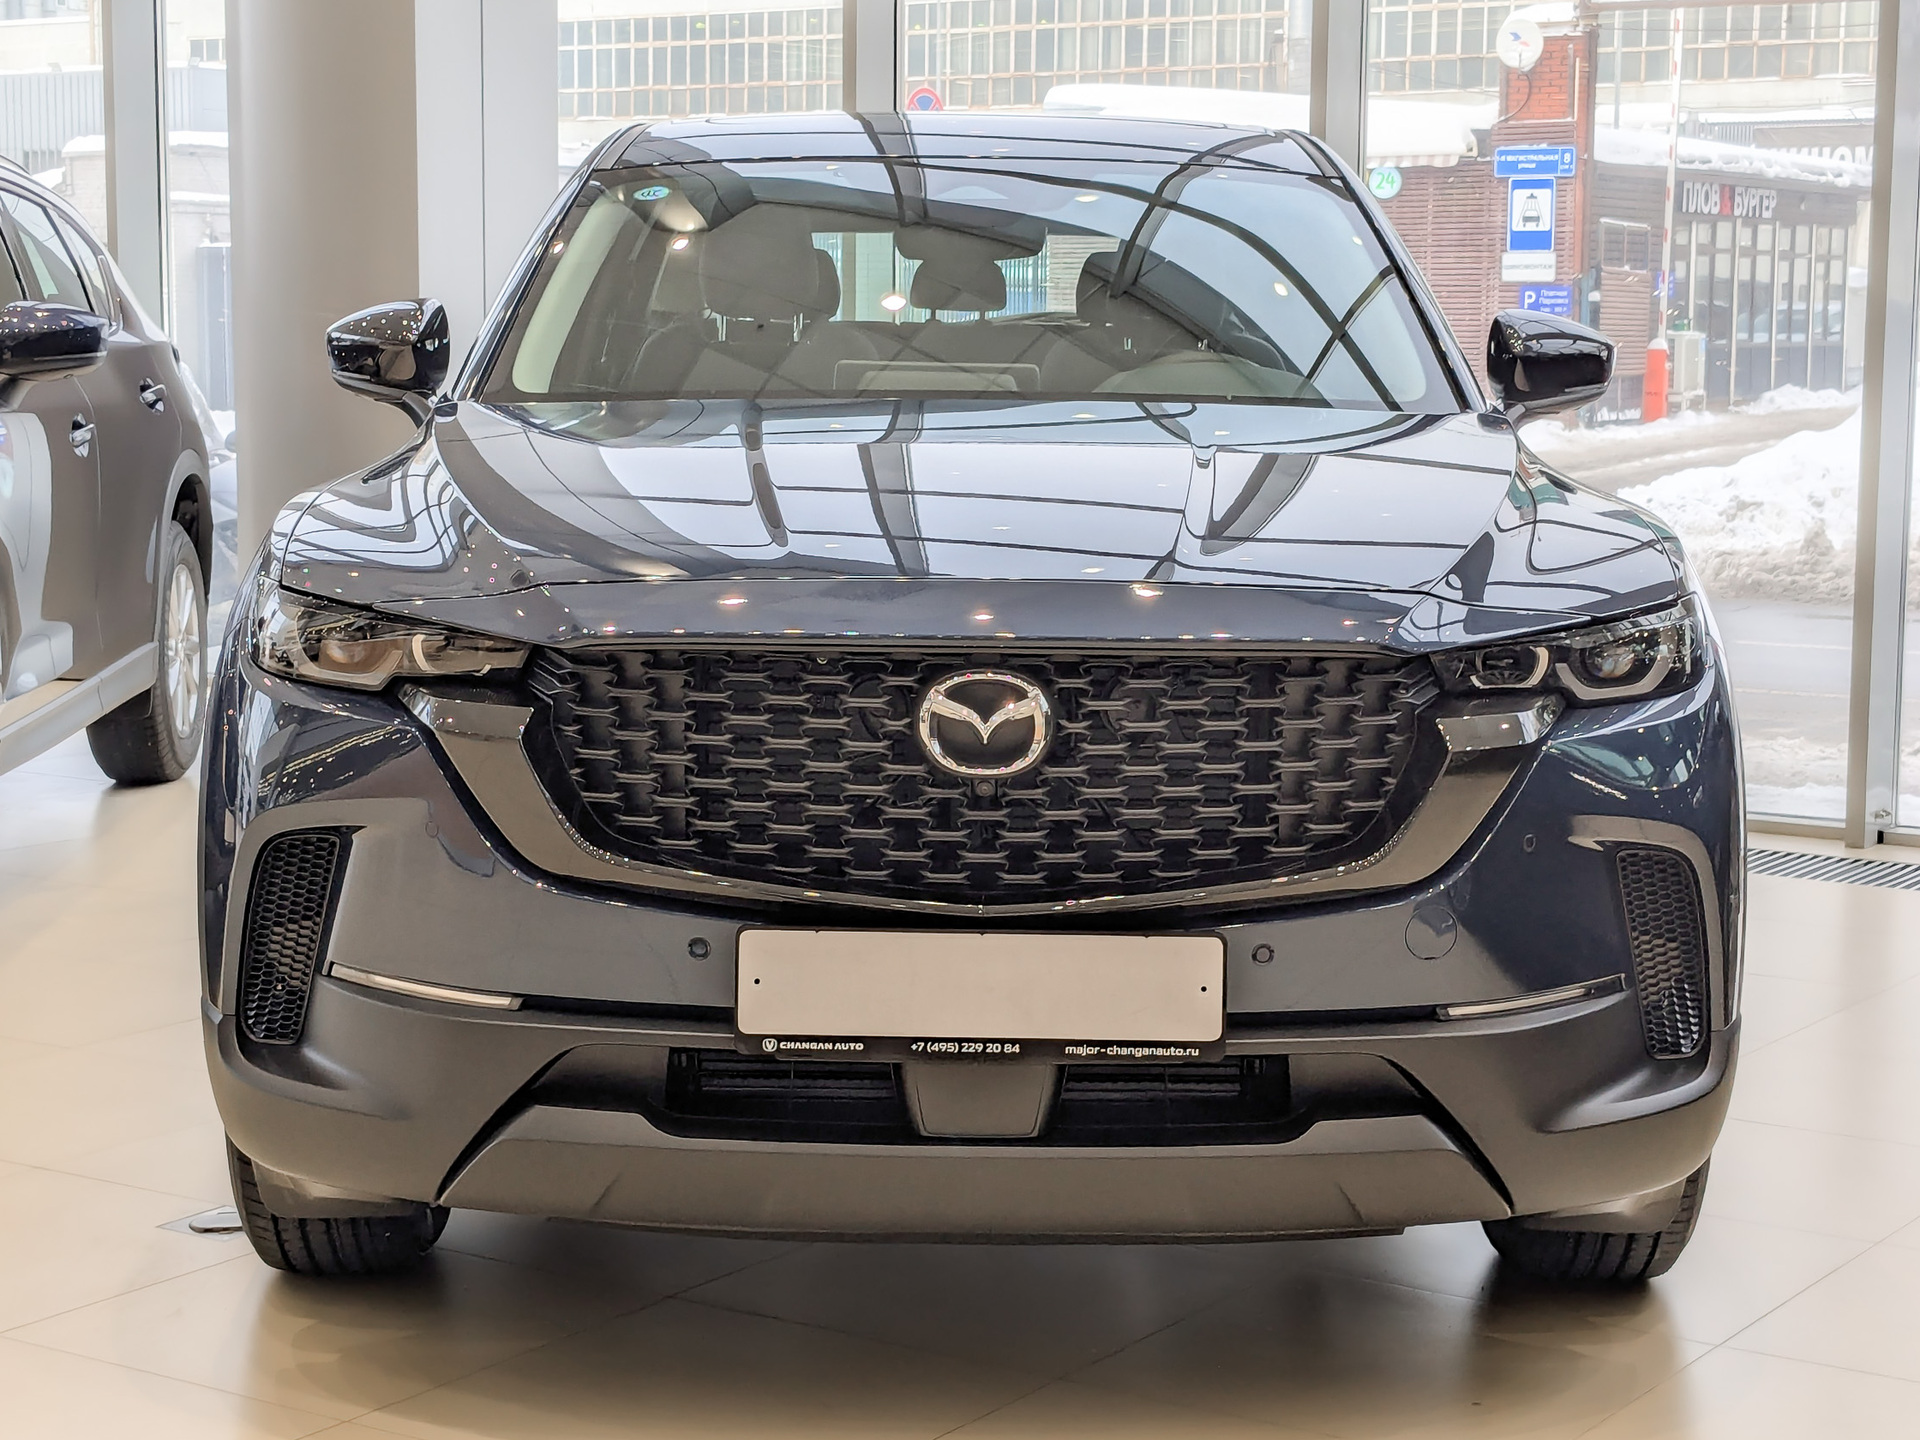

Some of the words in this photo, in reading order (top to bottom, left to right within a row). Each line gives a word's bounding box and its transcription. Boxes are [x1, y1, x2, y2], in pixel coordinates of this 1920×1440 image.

[1563, 152, 1571, 163] 8
[1375, 172, 1396, 189] 24
[1682, 181, 1720, 214] ПЛОВ
[1733, 186, 1777, 218] БУРГЕР
[780, 1041, 833, 1050] CHANGAN
[834, 1042, 864, 1051] AUTO
[911, 1042, 925, 1052] +7
[926, 1041, 959, 1053] (495)
[961, 1042, 984, 1053] 229
[985, 1043, 1001, 1053] 20
[1003, 1043, 1020, 1053] 84
[1065, 1044, 1199, 1058] major-changanauto.ru
